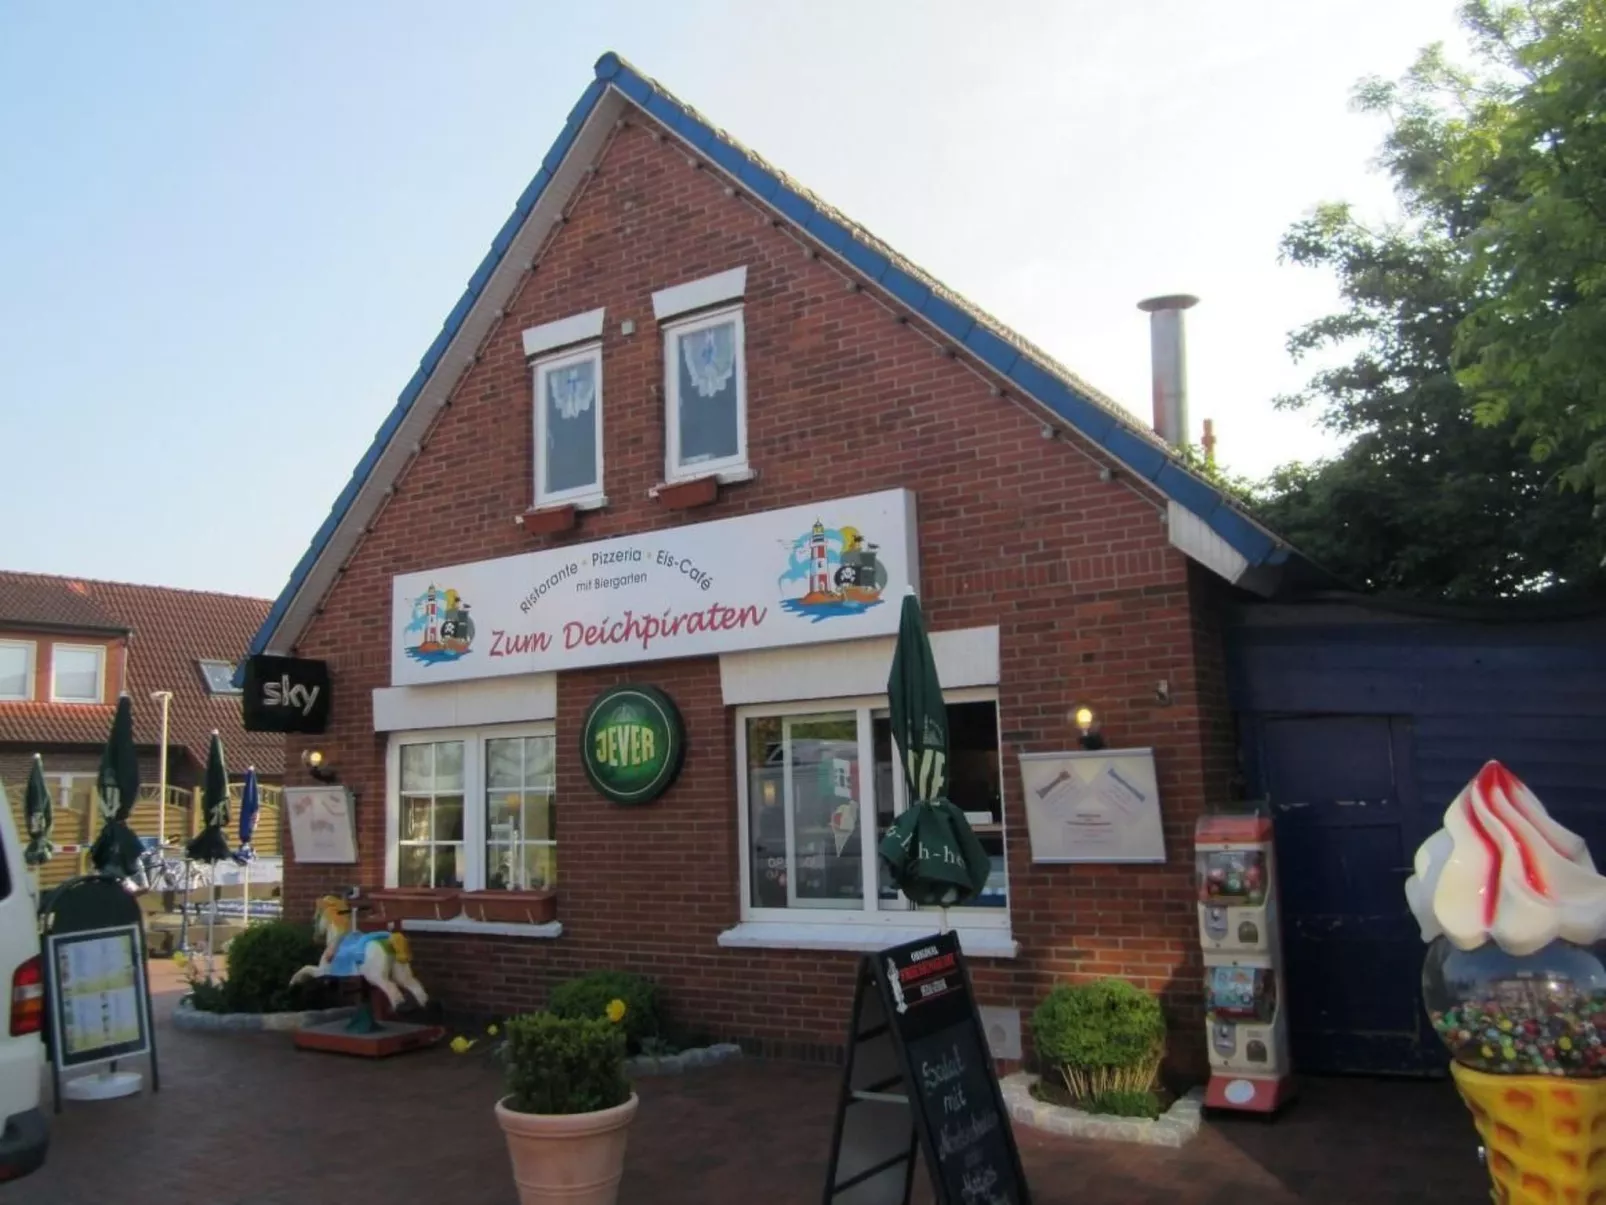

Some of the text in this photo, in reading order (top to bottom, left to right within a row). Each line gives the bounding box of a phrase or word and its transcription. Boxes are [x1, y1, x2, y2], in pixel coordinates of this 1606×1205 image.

[519, 547, 713, 614] Ristorante Pizzeria Eis-Café
[576, 572, 647, 592] mit Biergarten
[489, 602, 767, 658] Zum Deichpiraten
[263, 675, 320, 715] sky
[596, 725, 655, 766] JEVER
